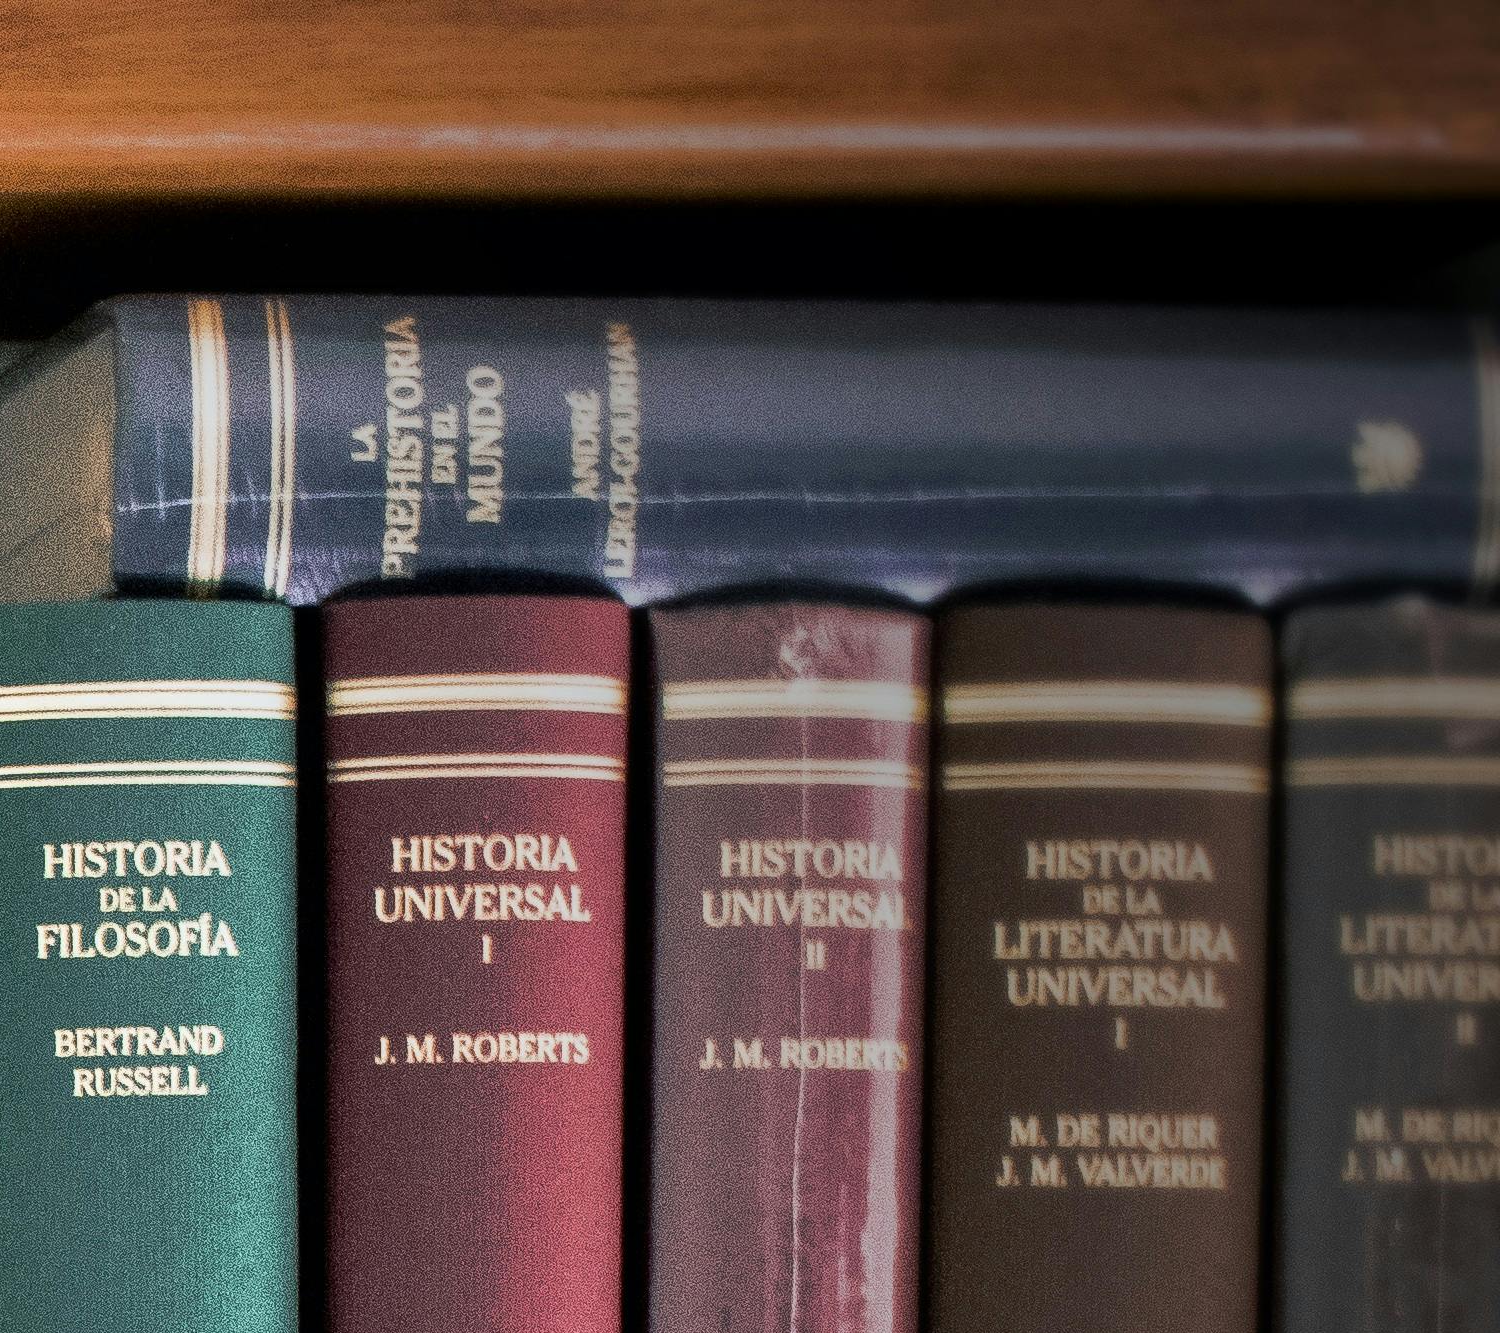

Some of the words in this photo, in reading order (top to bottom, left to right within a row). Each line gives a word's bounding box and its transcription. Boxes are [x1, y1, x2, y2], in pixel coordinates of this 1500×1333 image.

[352, 423, 377, 461] LA
[382, 319, 426, 574] PREHISTORIA
[466, 366, 505, 522] MUNDO
[44, 840, 232, 878] HISTORIA
[392, 834, 580, 873] HISTORIA
[721, 840, 903, 879] HISTORIA
[100, 887, 136, 913] DE
[142, 887, 178, 912] LA
[375, 883, 593, 923] UNIVERSAL
[702, 890, 905, 930] UNIVERSAL
[37, 912, 240, 959] FILOSOFÍA
[482, 934, 492, 964] I
[803, 940, 826, 970] II
[55, 1025, 225, 1057] BERTRAND
[374, 1036, 396, 1065] J.
[398, 1034, 443, 1063] M.
[453, 1032, 590, 1064] ROBERTS
[699, 1038, 723, 1070] J.
[734, 1039, 771, 1069] M.
[780, 1038, 905, 1070] ROBERTS
[73, 1065, 209, 1097] RUSSELL
